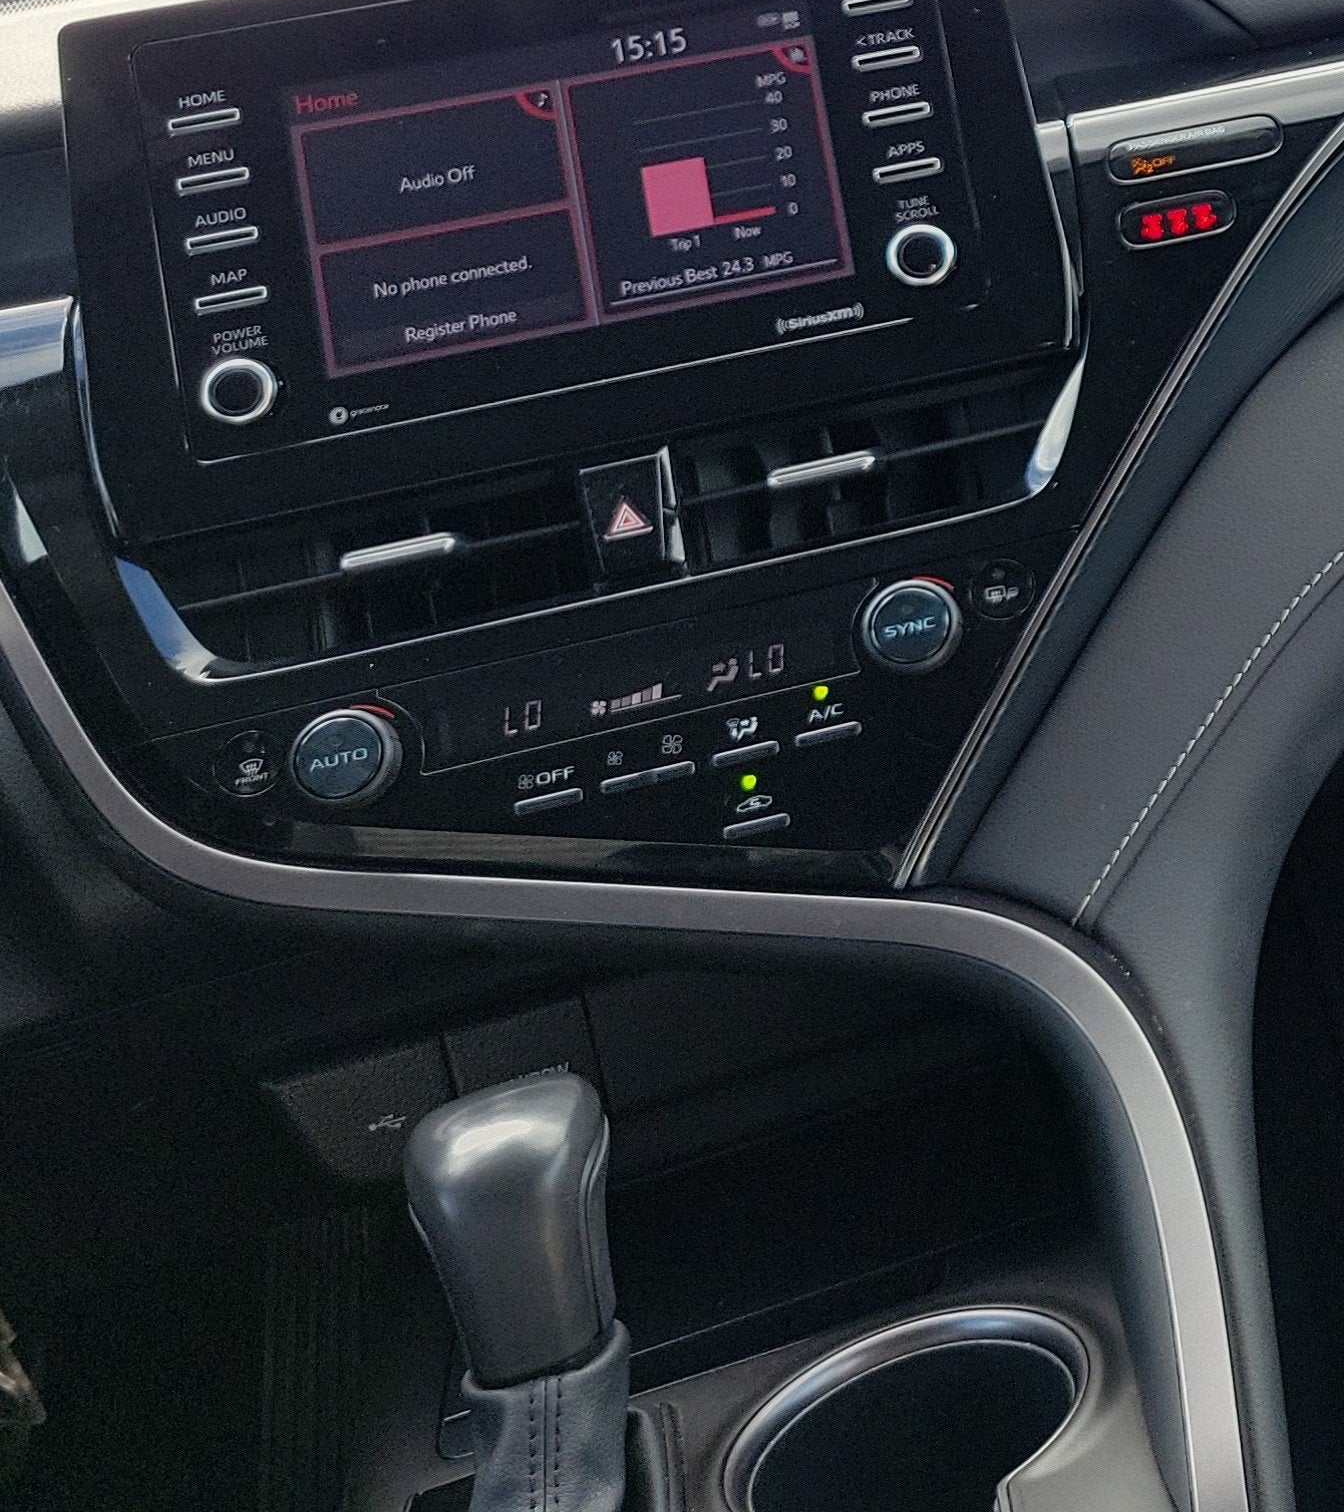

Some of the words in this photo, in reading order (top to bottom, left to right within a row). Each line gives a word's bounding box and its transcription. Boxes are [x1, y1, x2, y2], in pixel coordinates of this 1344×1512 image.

[611, 27, 688, 64] 15:15
[755, 71, 787, 88] MPG
[178, 90, 226, 109] HOME
[295, 91, 359, 114] Home
[764, 90, 784, 105] 40
[869, 84, 922, 103] PHONE
[769, 117, 788, 133] 30
[187, 148, 235, 169] MENU
[774, 145, 793, 160] 20
[886, 140, 926, 159] APPS
[400, 172, 445, 195] Audio
[447, 165, 476, 185] Off
[780, 172, 797, 188] 10
[787, 201, 799, 216] 0
[898, 195, 931, 209] TUNE
[194, 206, 248, 228] AUDIO
[895, 205, 940, 223] SCROLL
[733, 225, 763, 239] Now
[210, 268, 248, 287] MAP
[373, 283, 399, 300] No
[400, 274, 448, 298] phone
[450, 255, 534, 285] connected.
[620, 273, 684, 296] Previous
[685, 266, 719, 285] Best
[722, 256, 755, 277] 24.3
[762, 250, 794, 268] MPG
[213, 324, 262, 343] POWER
[405, 319, 466, 344] Register
[468, 310, 518, 331] Phone
[212, 336, 268, 356] VOLUME
[885, 616, 937, 639] SYNC
[808, 703, 844, 724] A/C
[310, 747, 368, 774] AUTO
[235, 771, 269, 787] FRONT
[535, 765, 575, 785] OFF
